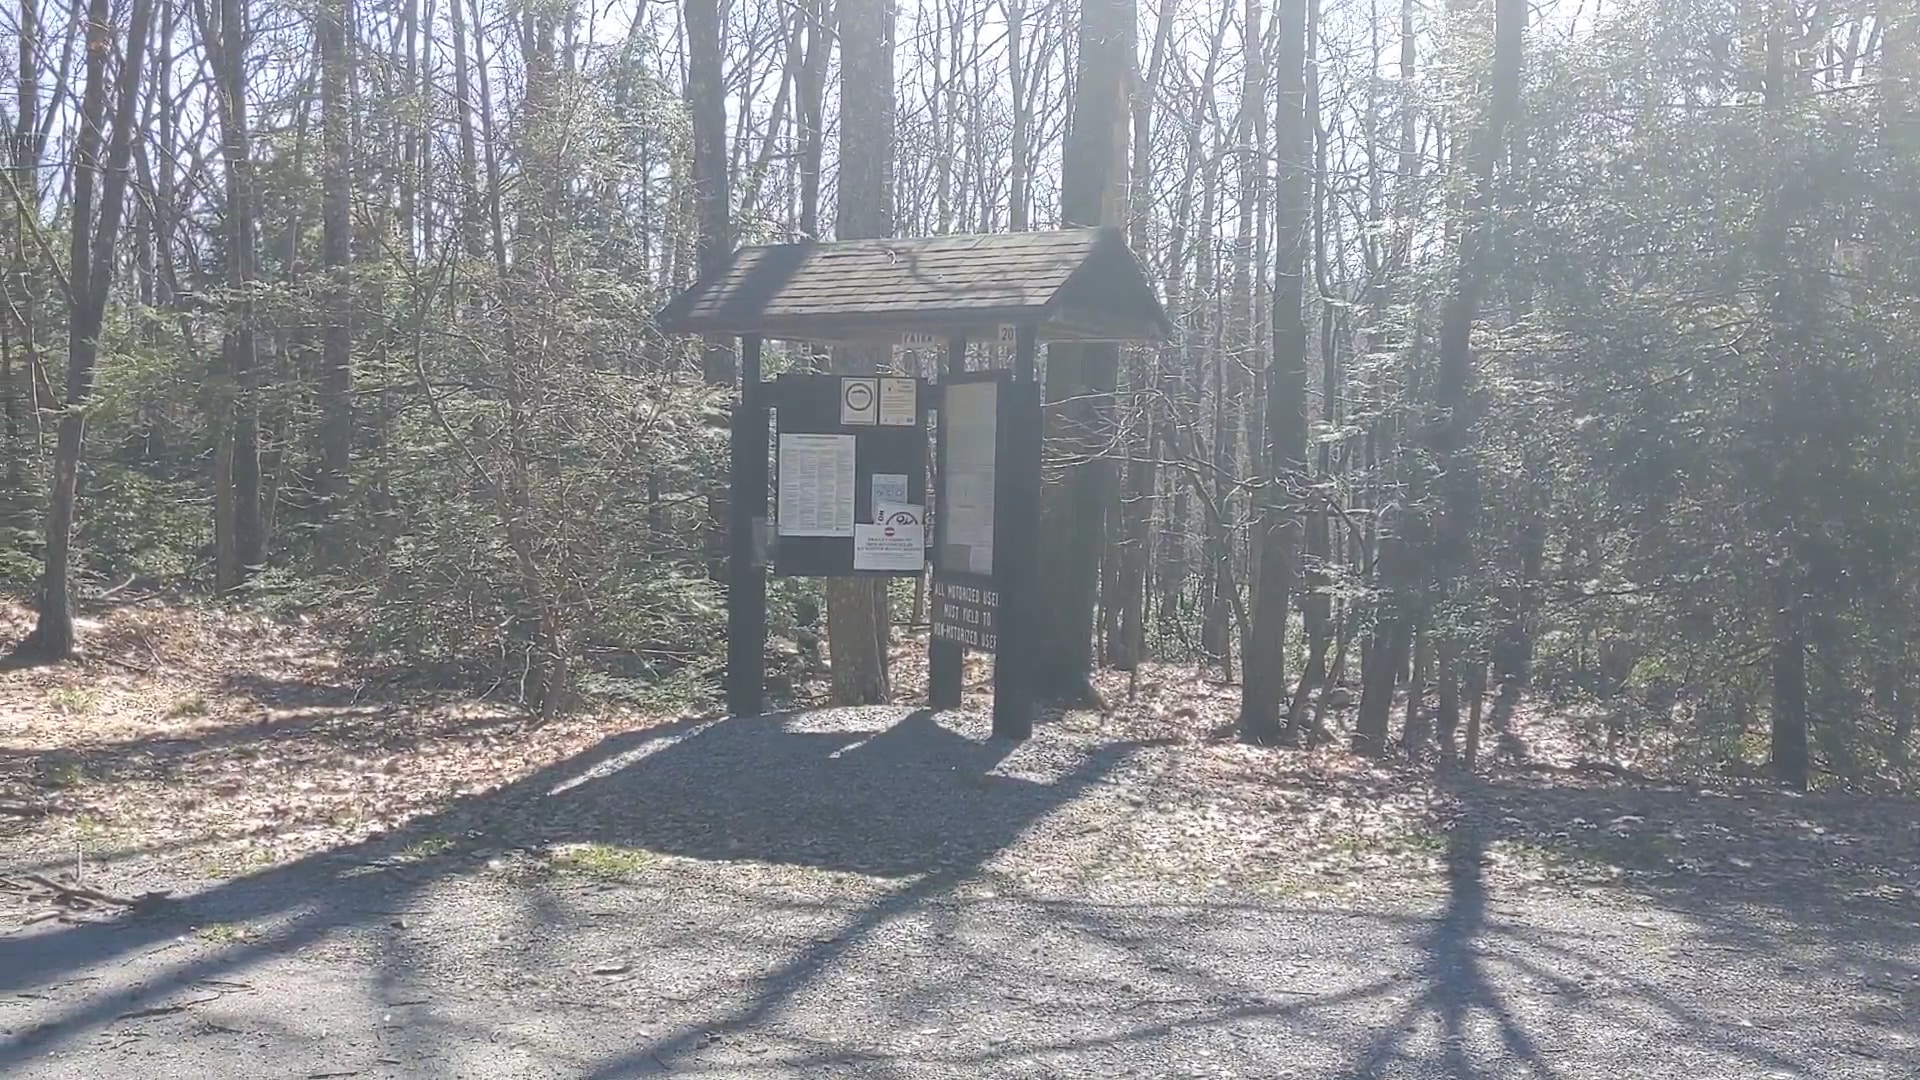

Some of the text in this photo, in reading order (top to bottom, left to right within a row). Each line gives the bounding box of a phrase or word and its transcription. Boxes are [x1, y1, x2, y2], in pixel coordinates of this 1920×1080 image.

[1001, 327, 1014, 341] 20
[934, 583, 945, 597] ALL
[947, 584, 980, 604] MOTORIZED
[944, 603, 992, 627] MUST YIELD TO
[934, 622, 978, 646] NON-MOTORIZED
